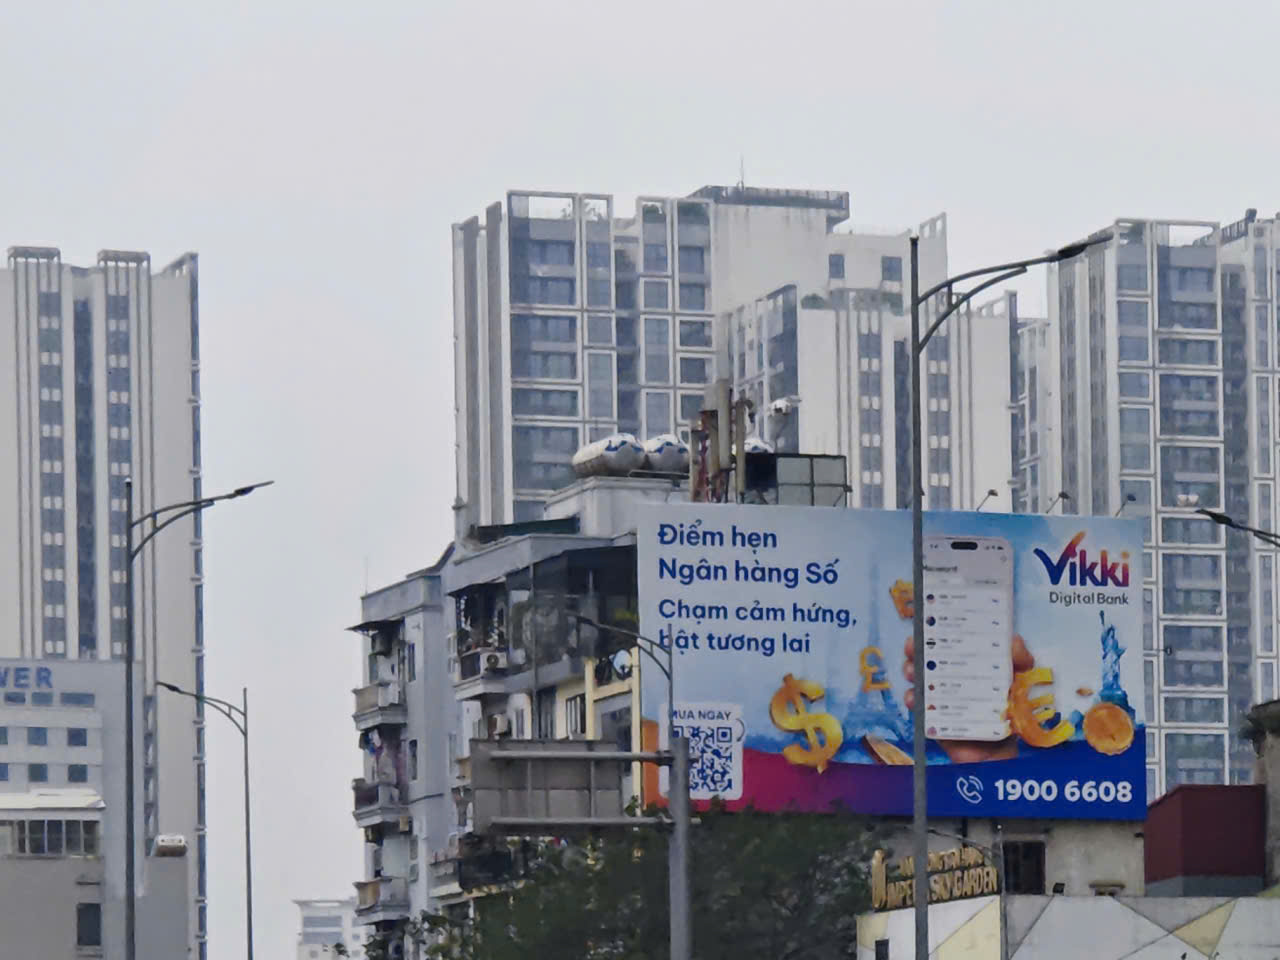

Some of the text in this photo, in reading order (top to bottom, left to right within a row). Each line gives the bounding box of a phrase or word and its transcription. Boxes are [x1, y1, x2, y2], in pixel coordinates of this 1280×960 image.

[657, 518, 777, 554] Điểm hẹn
[1033, 531, 1129, 587] Vikki
[658, 557, 840, 589] Ngân hàng Số
[1049, 591, 1129, 607] Digital Bank
[658, 599, 857, 628] Chạm cảm hứng,
[707, 632, 775, 657] tương
[782, 632, 810, 653] lai
[698, 710, 731, 720] NGAY
[994, 779, 1132, 803] 1900 6608
